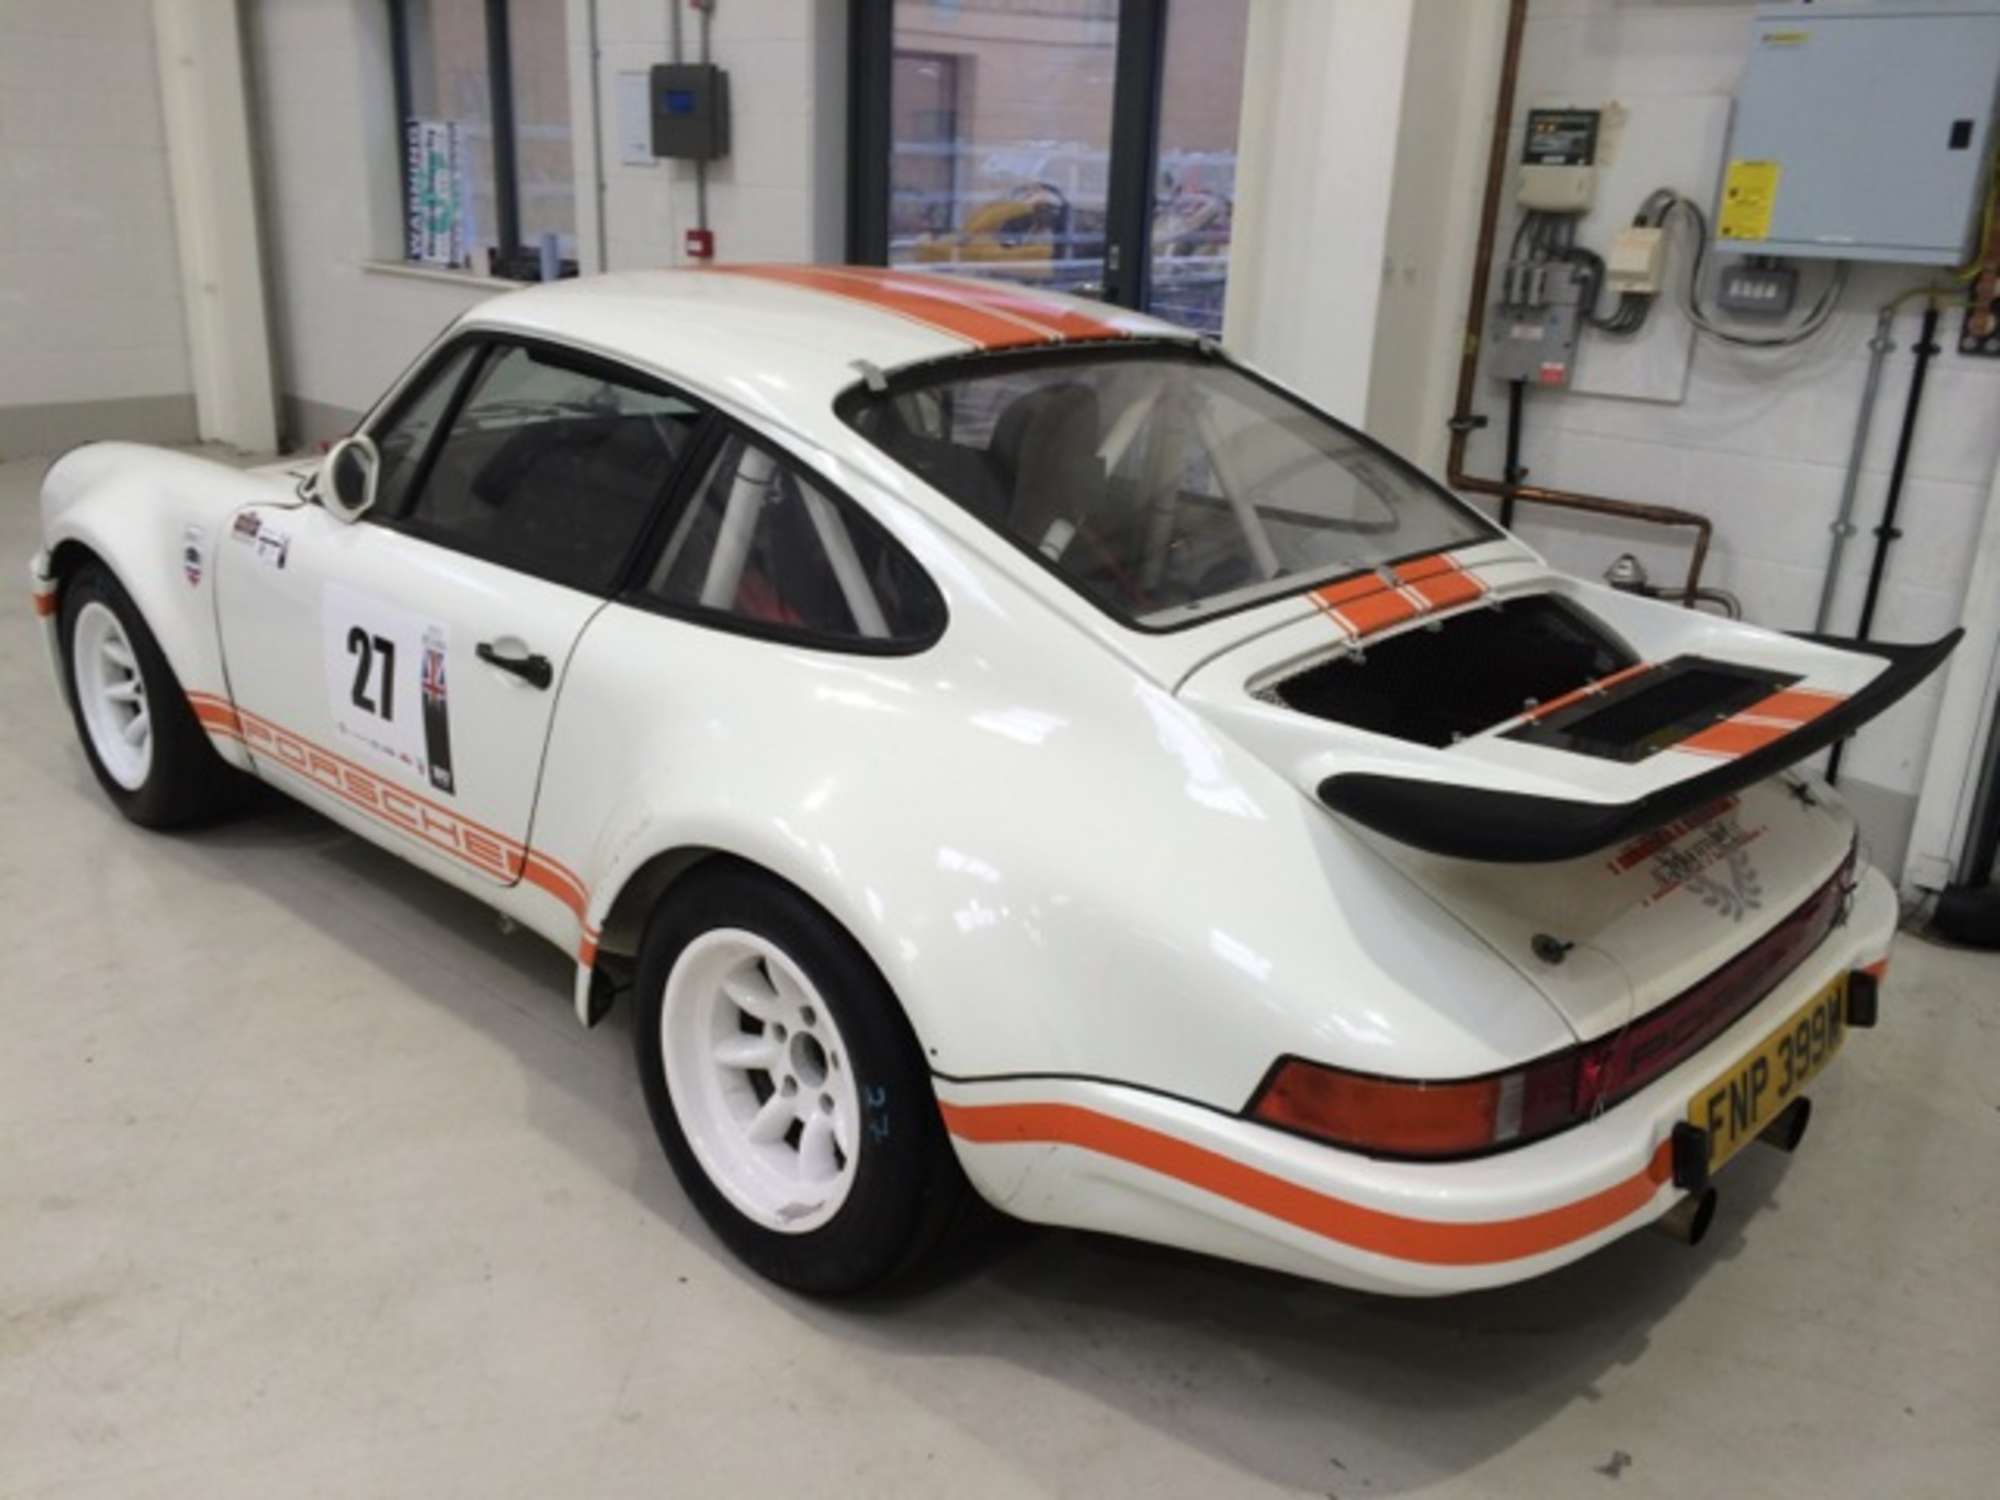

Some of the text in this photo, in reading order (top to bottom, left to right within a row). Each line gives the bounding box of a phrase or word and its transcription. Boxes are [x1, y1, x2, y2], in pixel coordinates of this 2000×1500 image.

[347, 625, 395, 722] 27
[242, 722, 505, 867] PORSCHE
[1706, 1055, 1769, 1158] FNP
